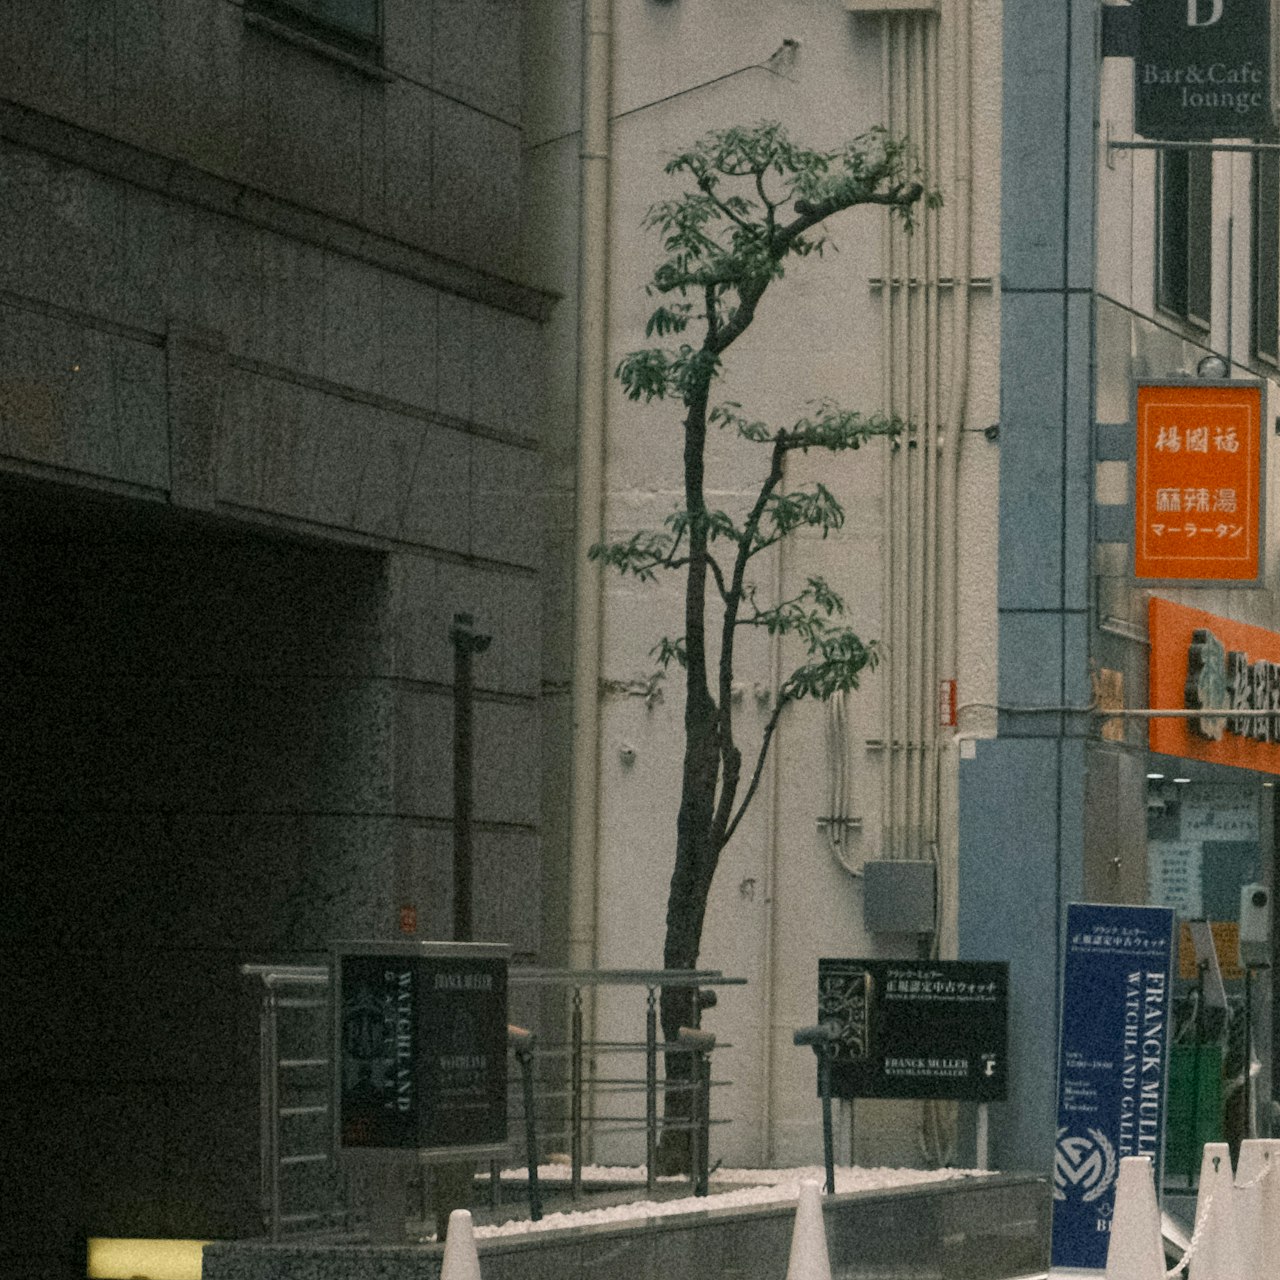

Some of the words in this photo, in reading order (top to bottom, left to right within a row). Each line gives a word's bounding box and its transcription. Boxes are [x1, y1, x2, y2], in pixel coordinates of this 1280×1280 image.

[1182, 87, 1262, 113] lounge
[1156, 487, 1237, 513] 麻辣湯
[1151, 522, 1244, 540] マーラータン
[1122, 971, 1141, 1089] WATCHLAND
[1142, 971, 1165, 1073] FRANCK
[885, 1057, 924, 1068] FRANCK
[928, 1058, 969, 1069] MULLER
